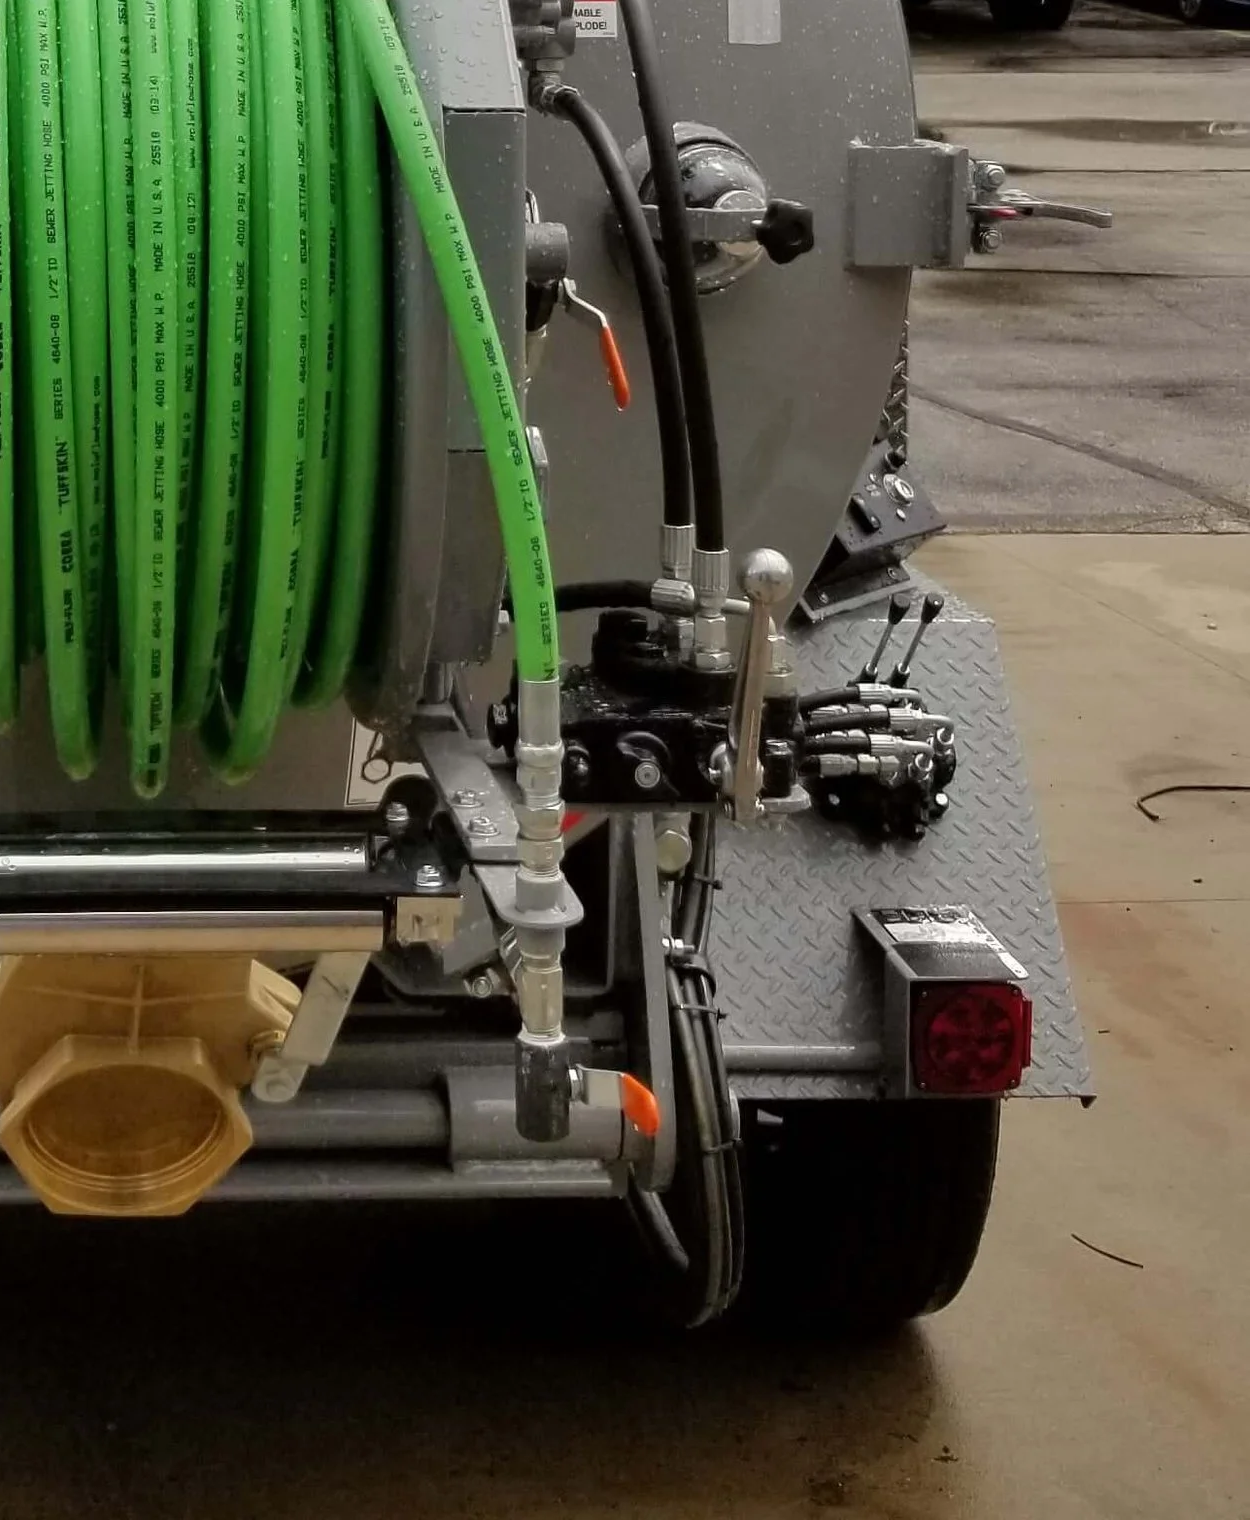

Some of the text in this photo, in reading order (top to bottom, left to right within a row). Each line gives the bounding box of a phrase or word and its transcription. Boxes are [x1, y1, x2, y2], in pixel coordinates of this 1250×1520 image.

[38, 33, 49, 52] MAX
[40, 58, 50, 76] PSI
[120, 73, 130, 86] IN
[236, 71, 247, 84] IN
[40, 82, 52, 108] 4000
[121, 92, 132, 119] MADE
[236, 90, 247, 117] MADE
[42, 120, 53, 148] HOSE
[421, 145, 434, 159] IN
[43, 153, 55, 202] JETTING
[236, 163, 247, 185] MAX
[428, 165, 446, 194] MADE
[236, 192, 247, 213] PSI
[298, 173, 308, 223] JETTING
[45, 208, 57, 244] SEWER
[152, 221, 164, 236] IN
[236, 219, 247, 248] 4000
[152, 243, 164, 272] MADE
[453, 239, 469, 262] MAX
[47, 258, 58, 272] ID
[185, 253, 196, 289] 25518
[234, 260, 245, 291] HOSE
[461, 267, 477, 290] PSI
[234, 295, 245, 346] JETTING
[470, 295, 485, 323] 4000
[49, 315, 61, 365] 4640-08
[154, 322, 165, 344] MAX
[154, 351, 165, 373] PSI
[185, 344, 195, 357] IN
[482, 337, 498, 367] HOSE
[184, 365, 196, 393] MADE
[233, 352, 243, 387] SEWER
[52, 378, 64, 420] SERIES
[154, 380, 165, 408] 4000
[493, 371, 514, 422] JETTING
[154, 421, 165, 450] HOSE
[507, 430, 524, 466] SEWER
[153, 456, 165, 503] JETTING
[519, 479, 531, 493] ID
[153, 509, 164, 541] SEWER
[60, 529, 74, 574] COBRA
[152, 553, 163, 566] ID
[530, 536, 546, 588] 4640-08
[539, 601, 552, 645] SERIES
